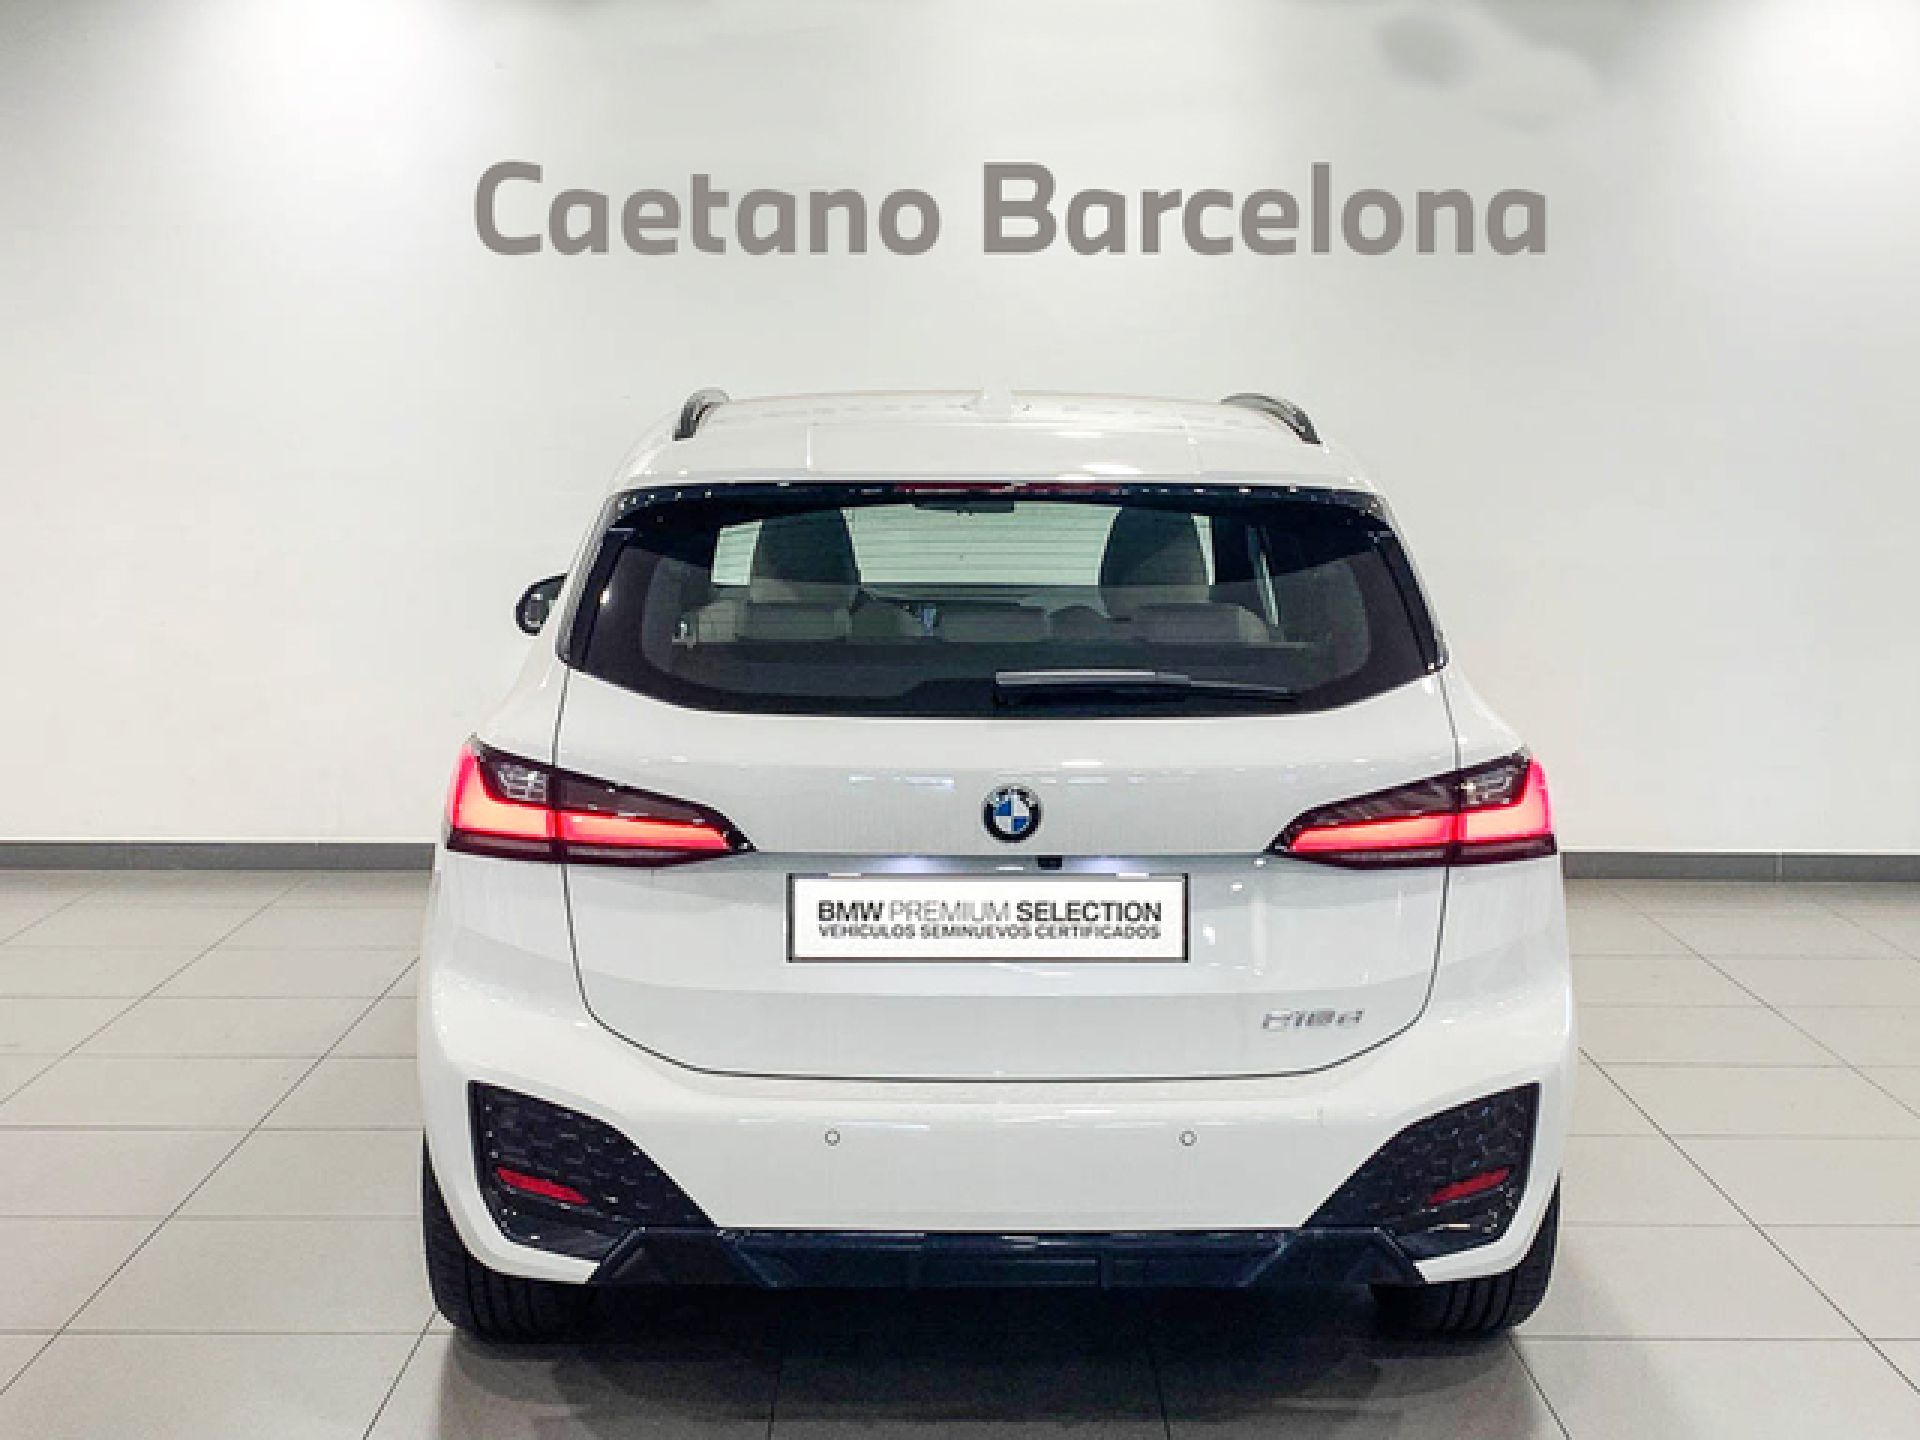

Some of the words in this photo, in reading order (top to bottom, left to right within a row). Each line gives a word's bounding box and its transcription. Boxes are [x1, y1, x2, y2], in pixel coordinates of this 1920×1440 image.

[475, 161, 941, 256] Caetano
[983, 161, 1548, 256] Barcelona
[818, 901, 884, 922] BMW
[890, 901, 1009, 922] PREMIUM
[1016, 901, 1162, 922] SELECTION
[920, 924, 1032, 940] SEMINUEVOS
[1035, 924, 1162, 940] CERTIFICADOS
